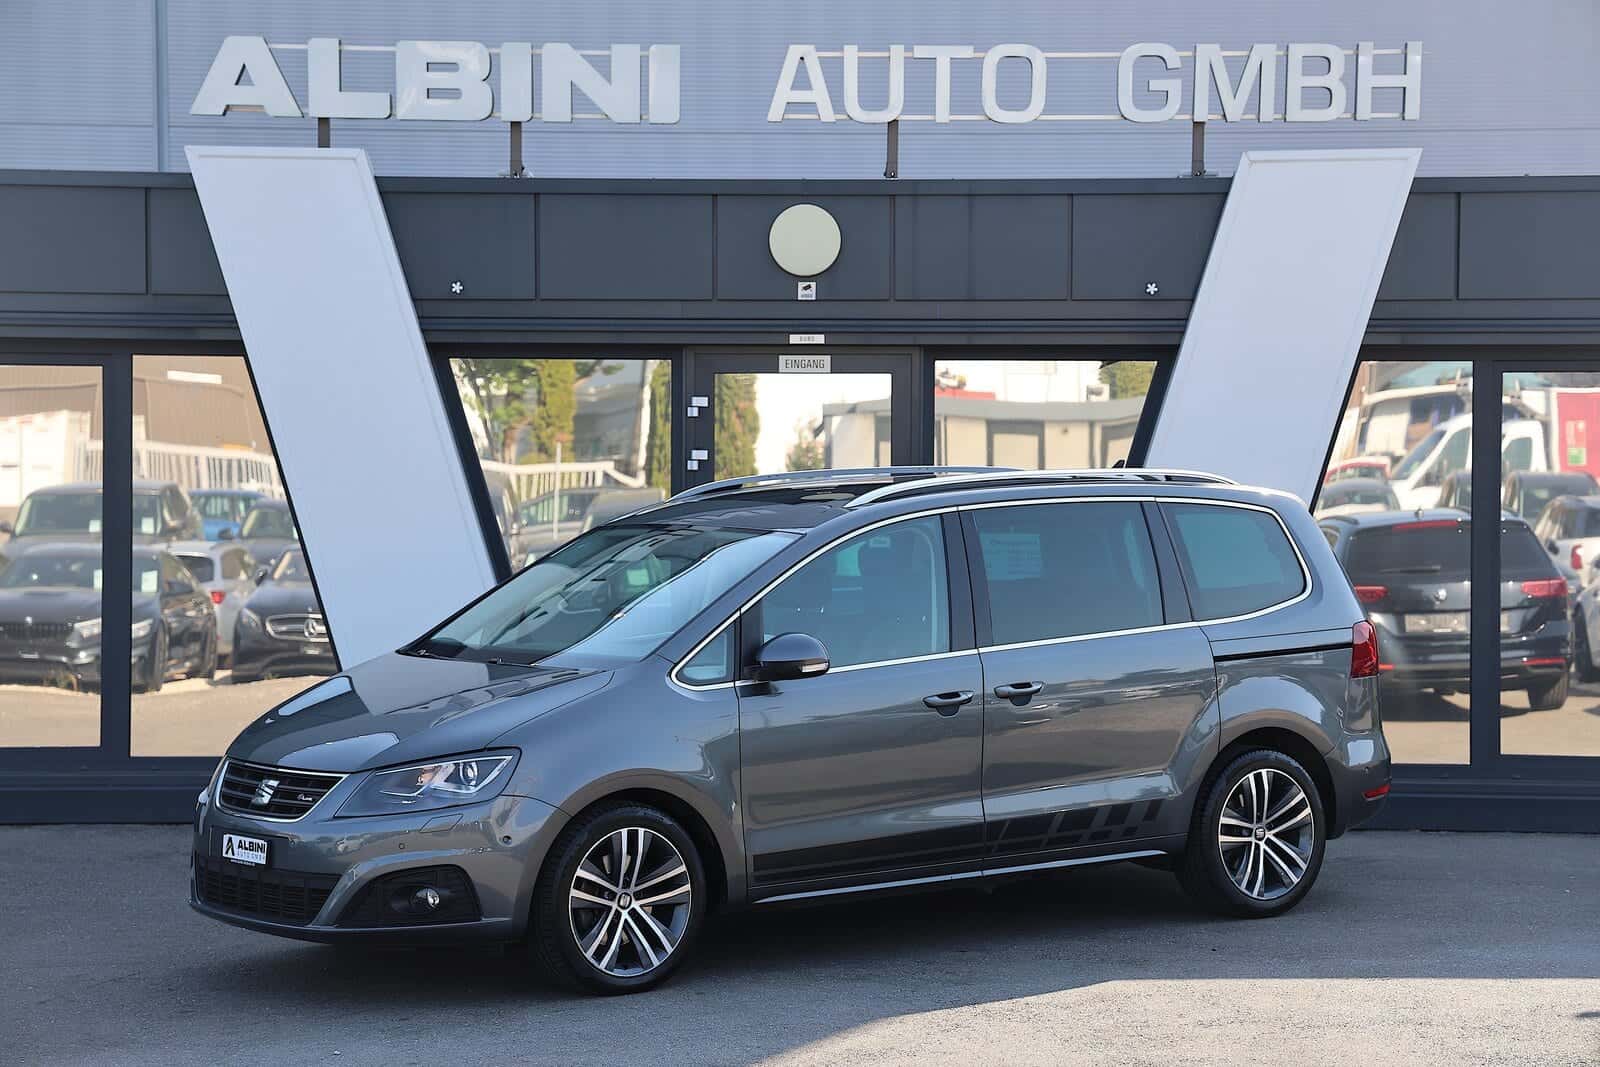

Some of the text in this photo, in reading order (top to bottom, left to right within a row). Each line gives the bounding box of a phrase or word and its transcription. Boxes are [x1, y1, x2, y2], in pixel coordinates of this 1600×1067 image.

[190, 36, 1423, 124] ALBINI AUTO GMBH
[785, 359, 825, 369] EINGANG
[238, 839, 266, 854] ALBINI
